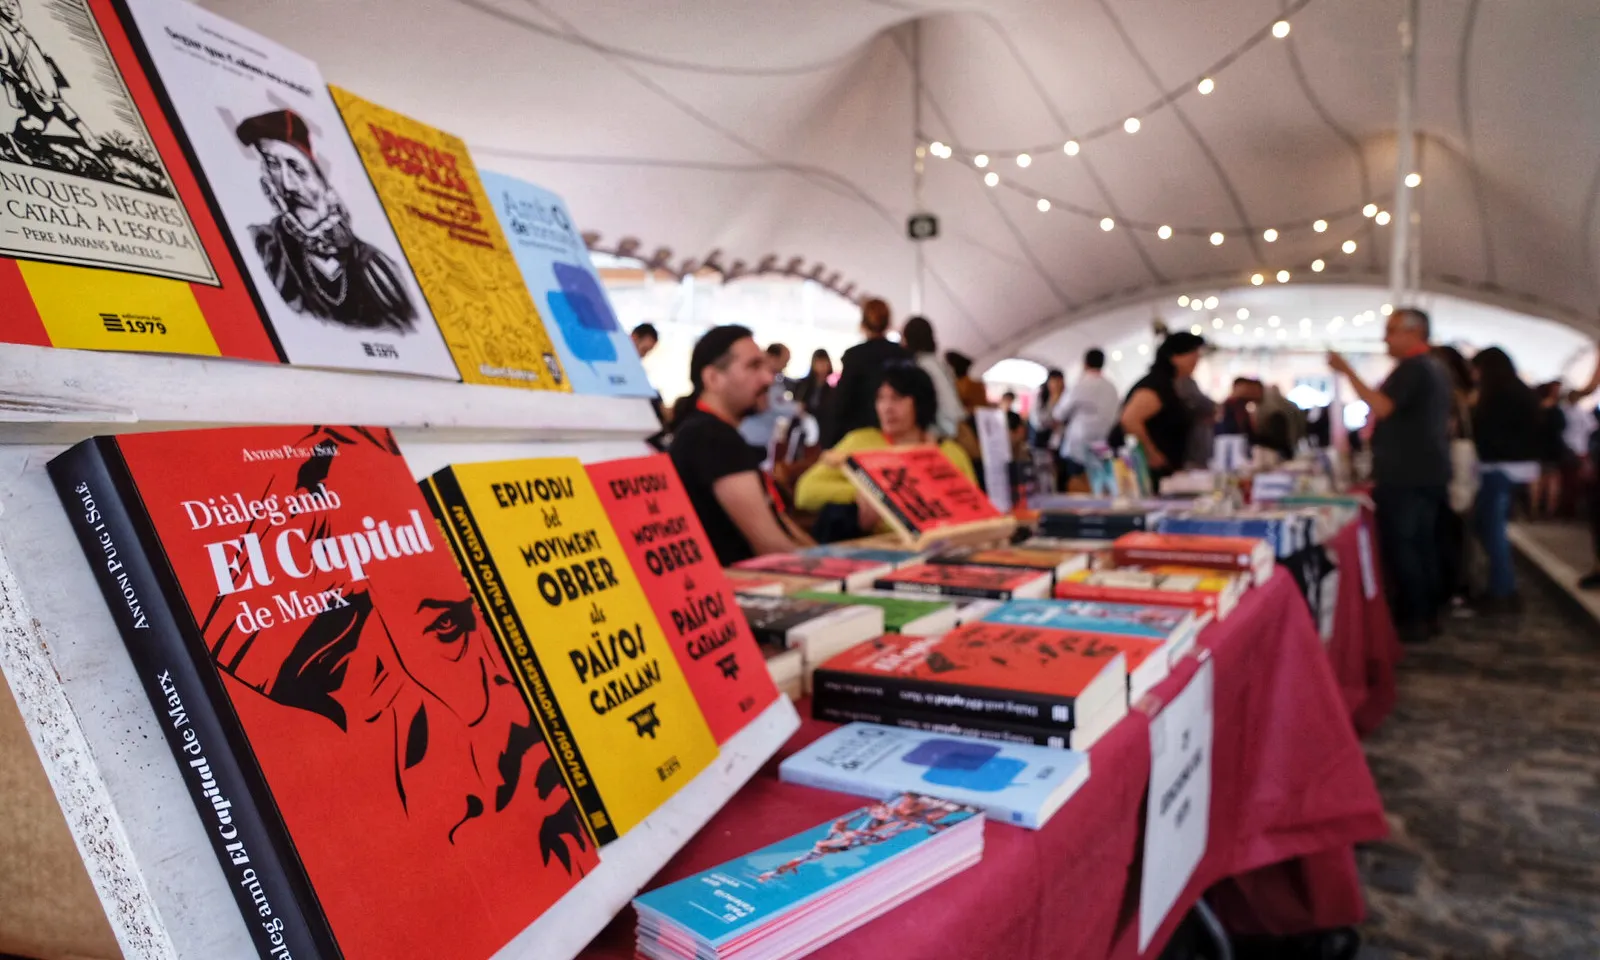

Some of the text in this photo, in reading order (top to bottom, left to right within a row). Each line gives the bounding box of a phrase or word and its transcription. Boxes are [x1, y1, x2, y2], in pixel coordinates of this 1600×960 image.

[0, 171, 184, 227] NIQUES NEGRES
[7, 199, 195, 249] CATALÀ A L'ESCOLA
[22, 226, 57, 243] PERE
[59, 233, 109, 252] MAYANS
[126, 320, 167, 335] 1979
[242, 447, 284, 462] ANTONI
[75, 481, 102, 524] SOLÉ
[181, 482, 342, 530] Diàleg amb
[491, 476, 576, 509] EPISODIS
[608, 472, 669, 500] EPISODIS
[541, 507, 562, 529] del
[630, 515, 691, 546] MOVIMENT
[98, 532, 123, 574] PUIG
[203, 531, 275, 597] El
[275, 509, 435, 582] Capital
[518, 529, 603, 568] MOVIMENT
[644, 535, 704, 577] OBRER
[116, 572, 150, 629] ANTONI
[536, 556, 620, 608] OBRER
[235, 587, 350, 634] de Marx
[568, 622, 647, 684] PAÏSOS
[157, 669, 190, 729] Marx
[589, 659, 662, 717] CATALANS
[183, 727, 201, 753] de
[189, 755, 239, 841] Capital
[226, 839, 250, 866] El
[241, 867, 272, 917] amb
